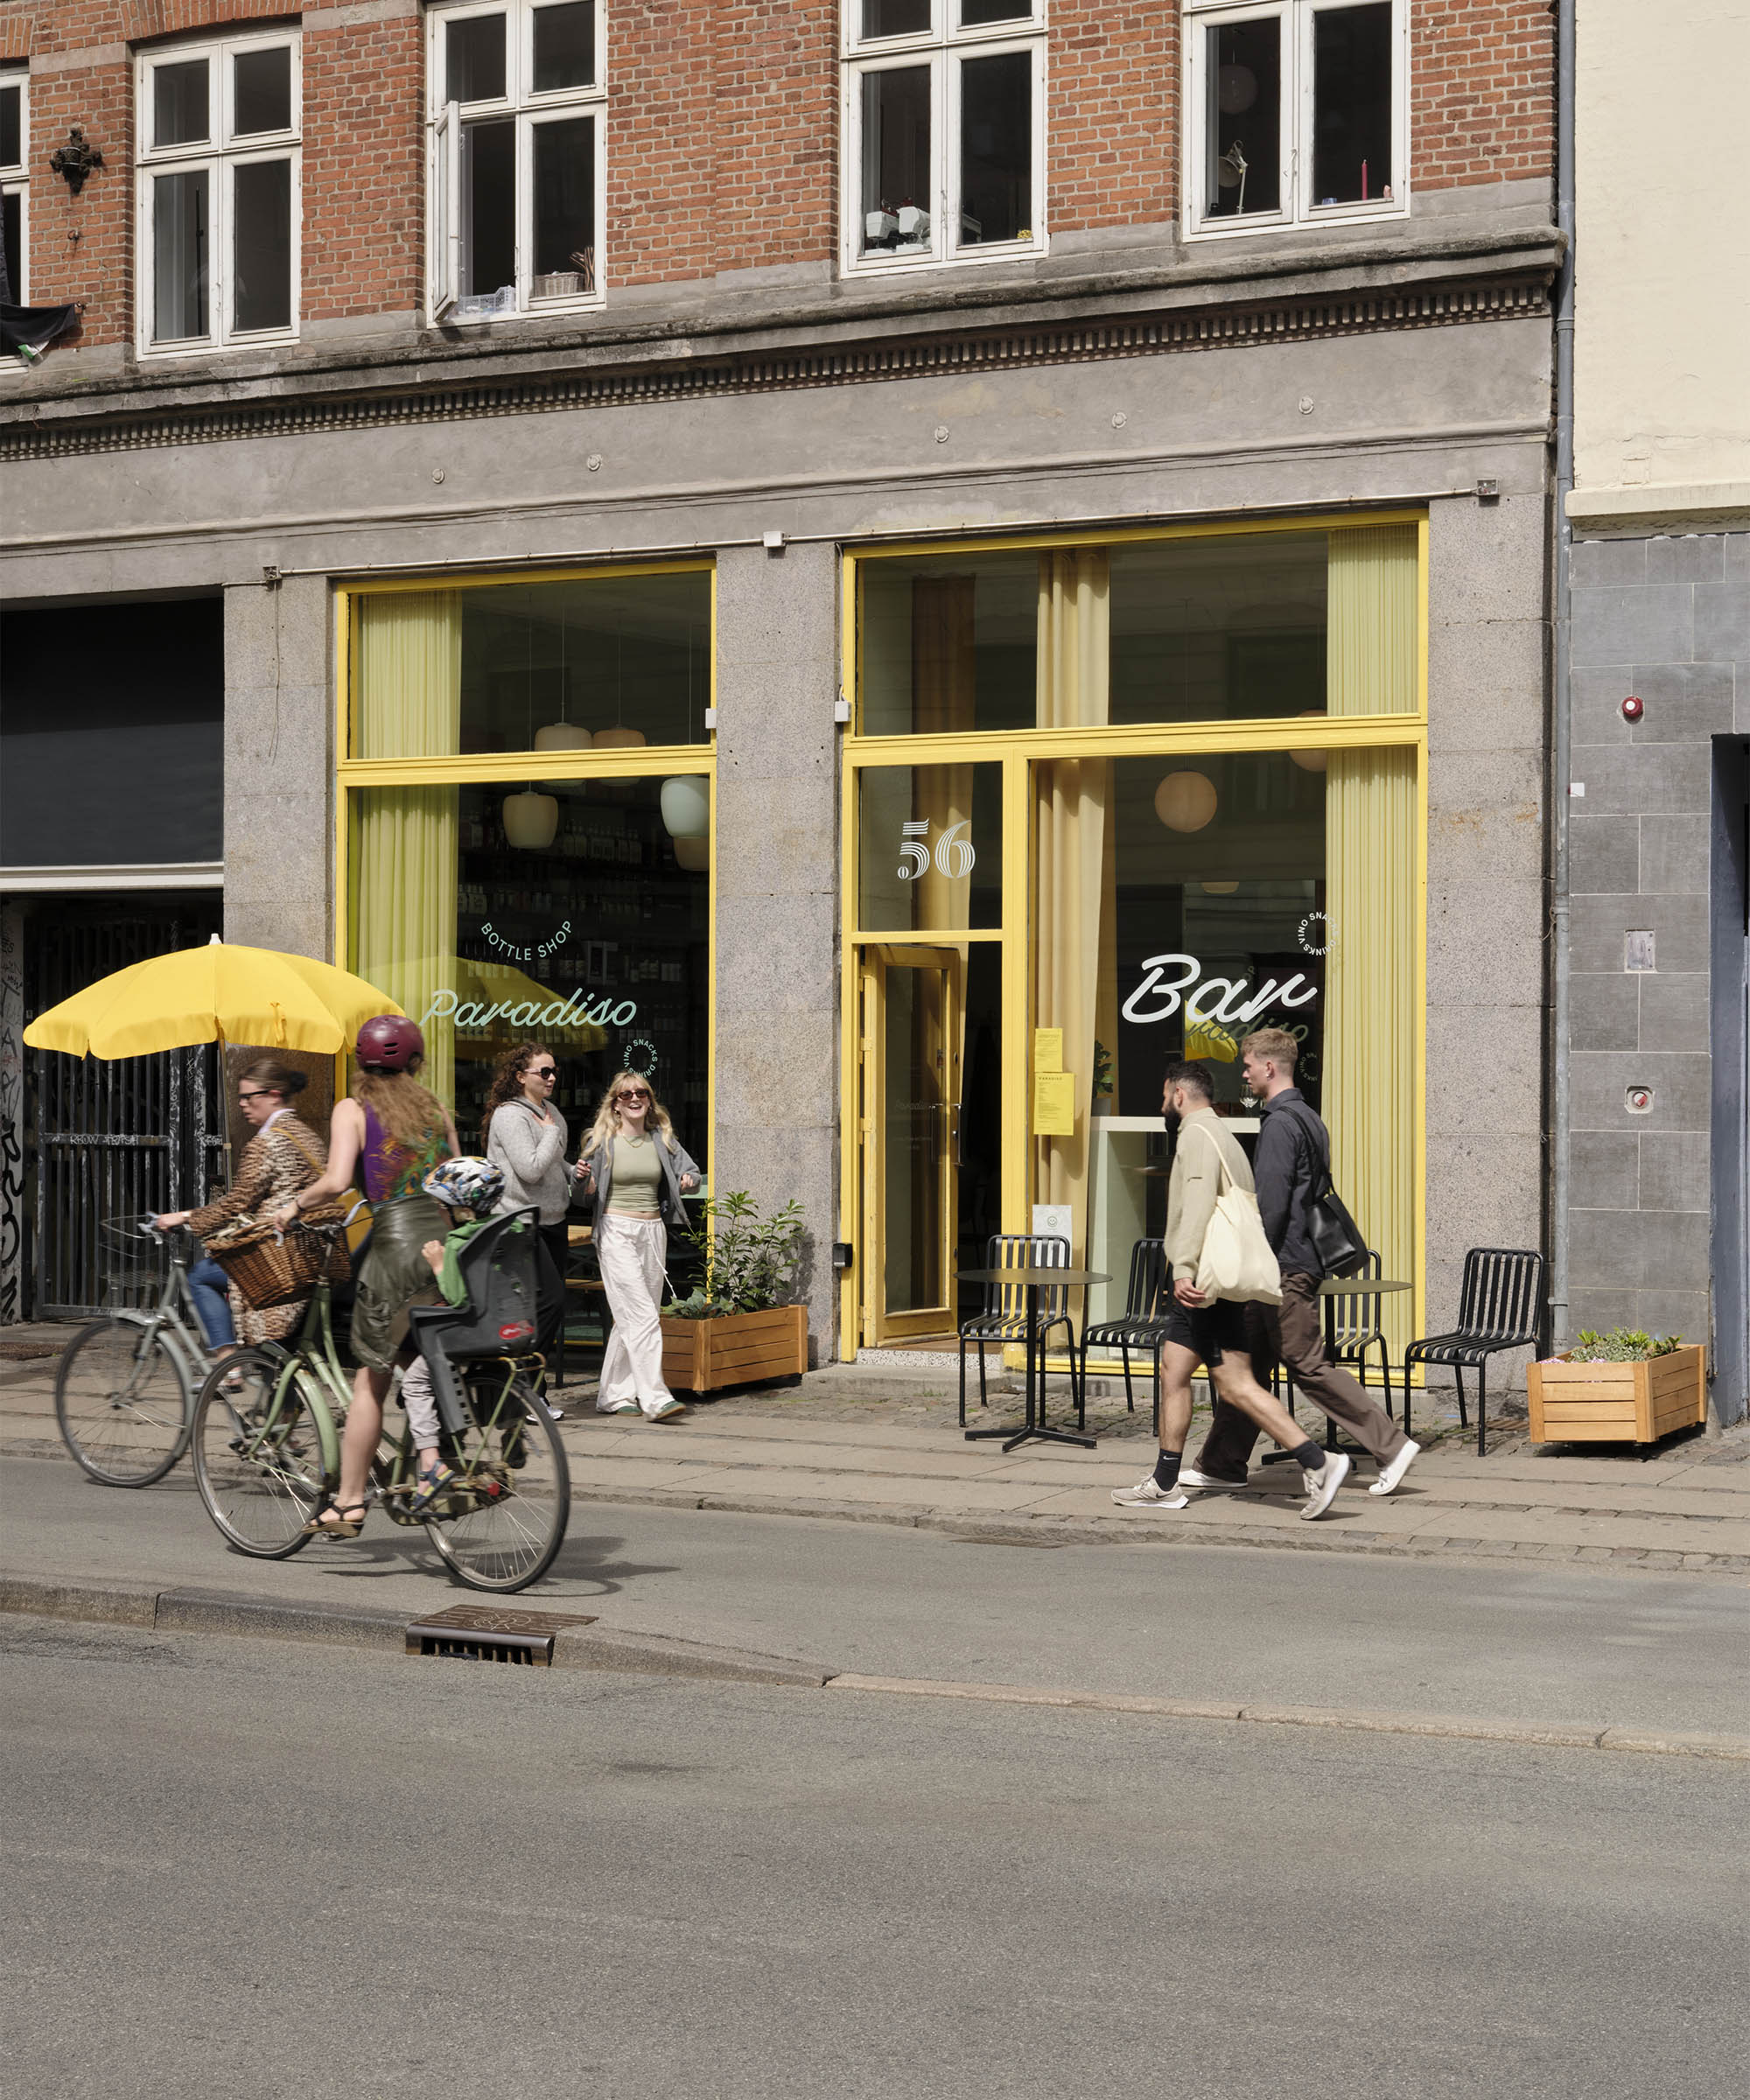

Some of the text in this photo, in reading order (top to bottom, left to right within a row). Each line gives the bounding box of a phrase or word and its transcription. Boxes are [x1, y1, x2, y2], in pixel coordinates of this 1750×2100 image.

[897, 816, 976, 880] 56
[480, 920, 573, 961] BOTTLE SHOP
[1298, 919, 1308, 944] VINO
[418, 987, 638, 1027] Paradiso
[1121, 953, 1319, 1024] Bar
[623, 1045, 633, 1068] VINO
[633, 1038, 659, 1062] SNACKS
